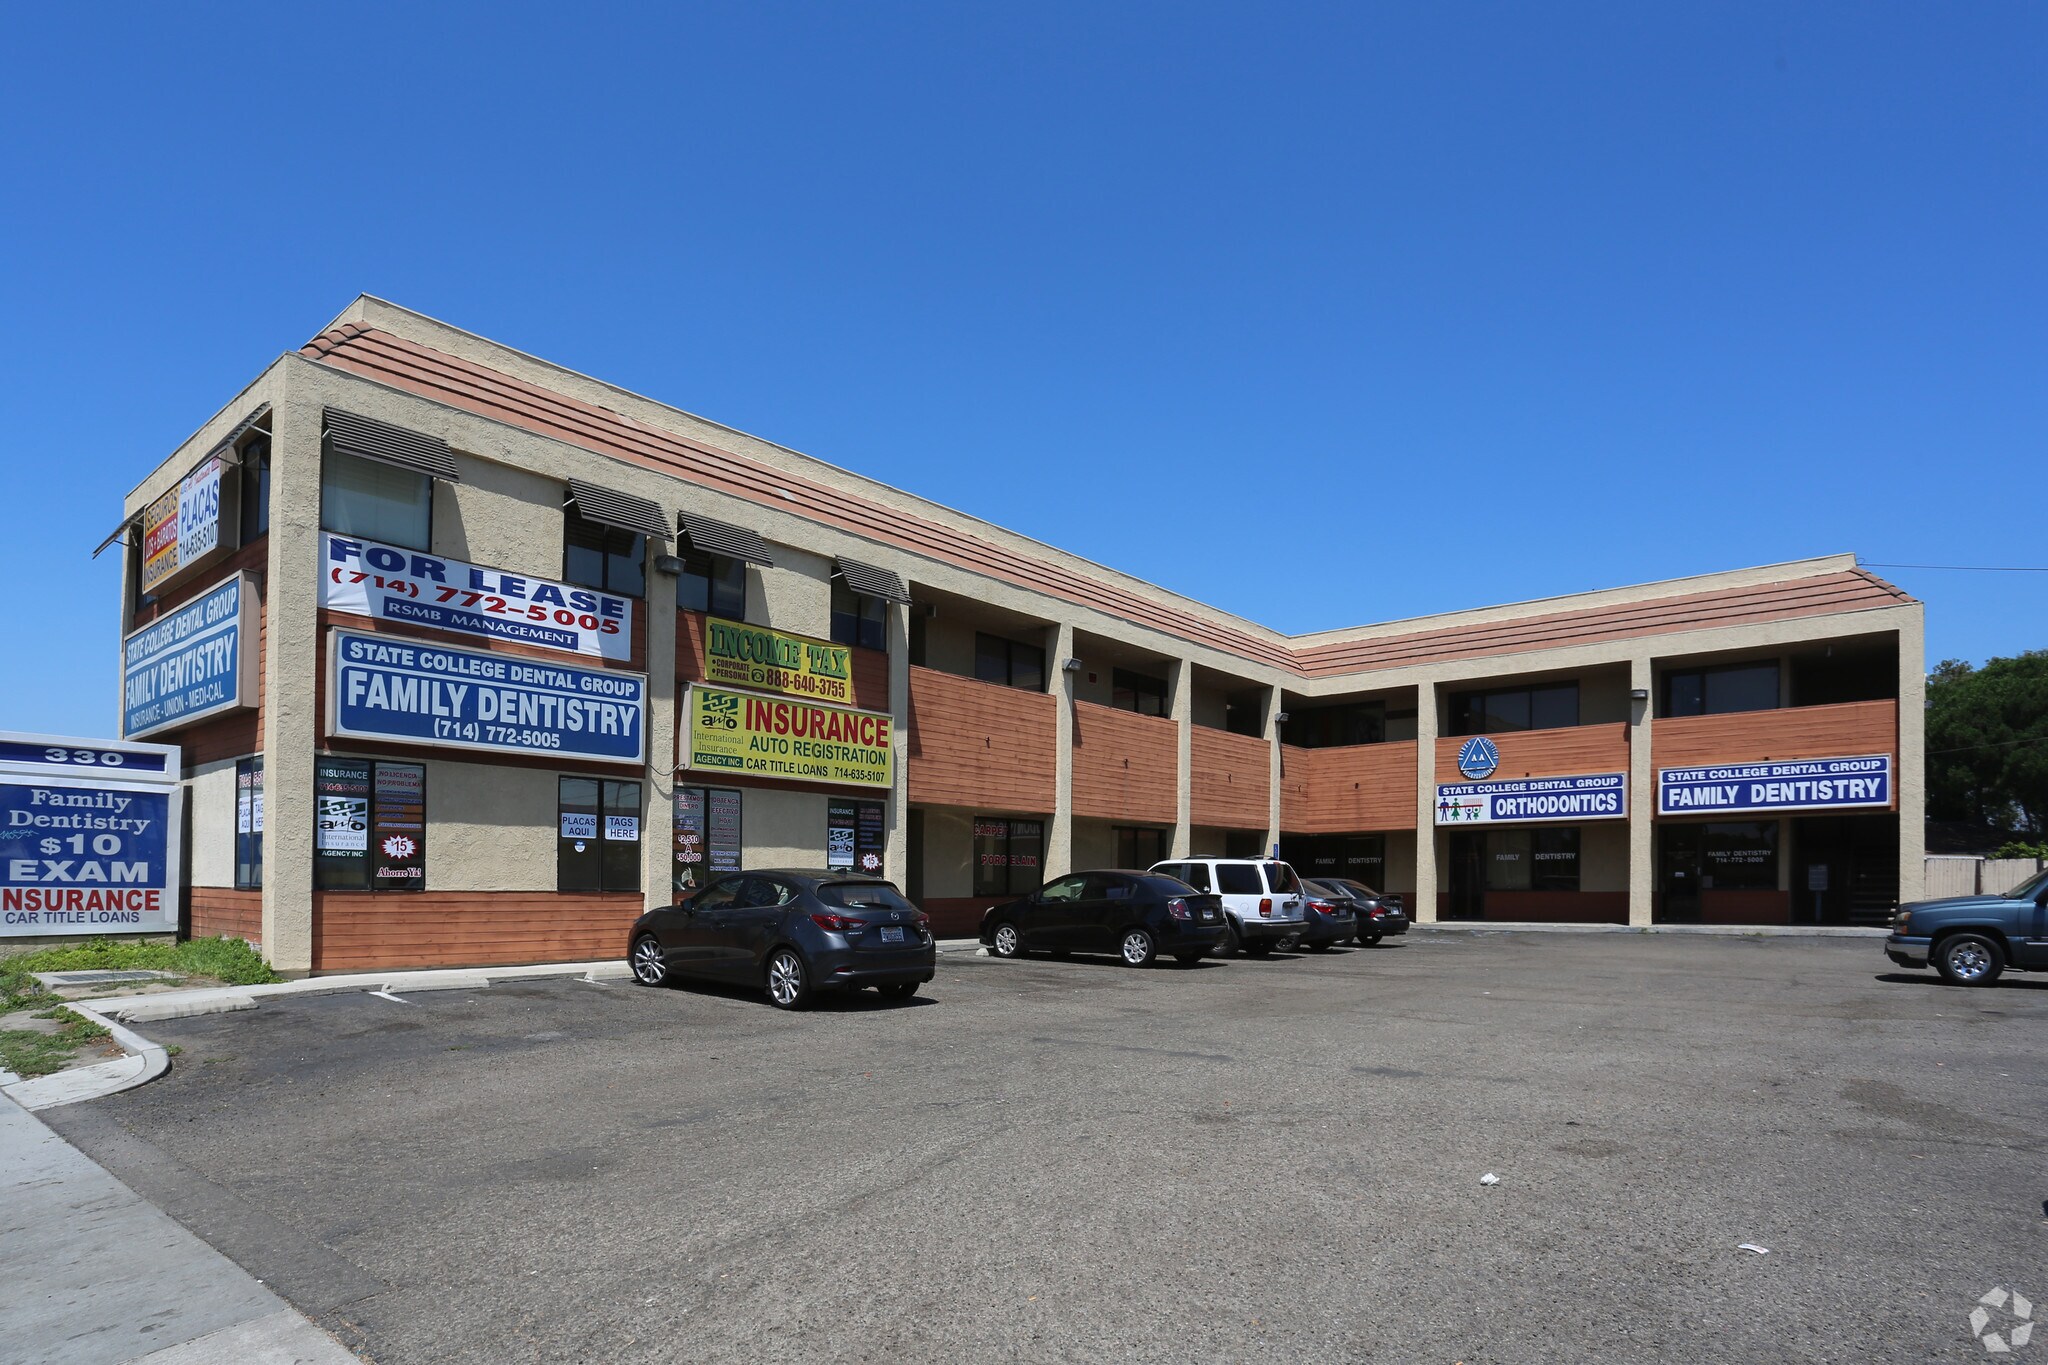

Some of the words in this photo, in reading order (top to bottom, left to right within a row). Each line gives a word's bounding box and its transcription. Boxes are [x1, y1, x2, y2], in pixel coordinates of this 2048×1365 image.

[147, 488, 178, 531] SEGUROS
[181, 479, 218, 536] PLACAS
[157, 518, 177, 551] BARATOS
[179, 520, 218, 563] 714-635-5107
[329, 537, 446, 583] FOR
[469, 567, 624, 620] LEASE
[331, 567, 419, 598] (714)
[435, 585, 620, 635] 772-5005
[127, 637, 144, 665] STATE
[144, 619, 174, 656] COLLEGE
[175, 603, 204, 640] DENTAL
[206, 586, 237, 624] GROUP
[388, 602, 441, 621] RSMB
[451, 614, 575, 645] MANAGEMENT
[709, 623, 801, 671] INCOME
[807, 645, 848, 679] TAX
[125, 666, 159, 712] FAMILY
[160, 631, 236, 697] DENTISTRY
[350, 641, 414, 667] STATE
[419, 652, 505, 680] COLLEGE
[510, 665, 576, 690] DENTAL
[580, 676, 635, 697] GROUP
[766, 668, 845, 699] 888-640-3755
[131, 703, 161, 730] INSURANCE
[164, 694, 184, 717] UNION
[189, 681, 224, 708] MEDI-CAL
[347, 669, 471, 719] FAMILY
[477, 687, 636, 737] DENTISTRY
[702, 710, 738, 730] auto
[745, 698, 889, 749] INSURANCE
[433, 718, 480, 742] (714)
[487, 725, 561, 749] 772-5005
[693, 730, 744, 745] International
[45, 748, 124, 766] 330
[695, 755, 727, 766] AGENCY
[698, 742, 738, 755] Insurance
[749, 736, 789, 755] AUTO
[793, 741, 886, 765] REGISTRATION
[320, 768, 368, 780] INSURANCE
[746, 757, 767, 771] CAR
[770, 760, 795, 773] TITLE
[797, 763, 828, 777] LOANS
[834, 767, 885, 782] 714-635-5107
[1668, 771, 1706, 781] STATE
[1709, 767, 1769, 779] COLLEGE
[1773, 764, 1826, 776] DENTAL
[1829, 760, 1881, 773] GROUP
[1442, 785, 1474, 795] STATE
[1477, 783, 1527, 794] COLLEGE
[1530, 780, 1573, 791] DENTAL
[1576, 777, 1619, 788] GROUP
[1669, 785, 1739, 807] FAMILY
[1751, 778, 1881, 804] DENTISTRY
[31, 789, 132, 814] Family
[239, 807, 251, 818] PLACA
[1495, 792, 1617, 816] ORTHODONTICS
[9, 809, 151, 835] Dentistry
[319, 816, 366, 832] auto
[562, 816, 596, 826] PLACAS
[569, 827, 590, 836] AQUI
[609, 817, 633, 827] TAGS
[610, 829, 634, 838] HERE
[40, 833, 122, 856] $10
[9, 859, 149, 883] EXAM
[2, 888, 160, 912] NSURANCE
[5, 912, 39, 924] CAR
[44, 911, 85, 924] TITLE
[90, 911, 140, 924] LOANS
